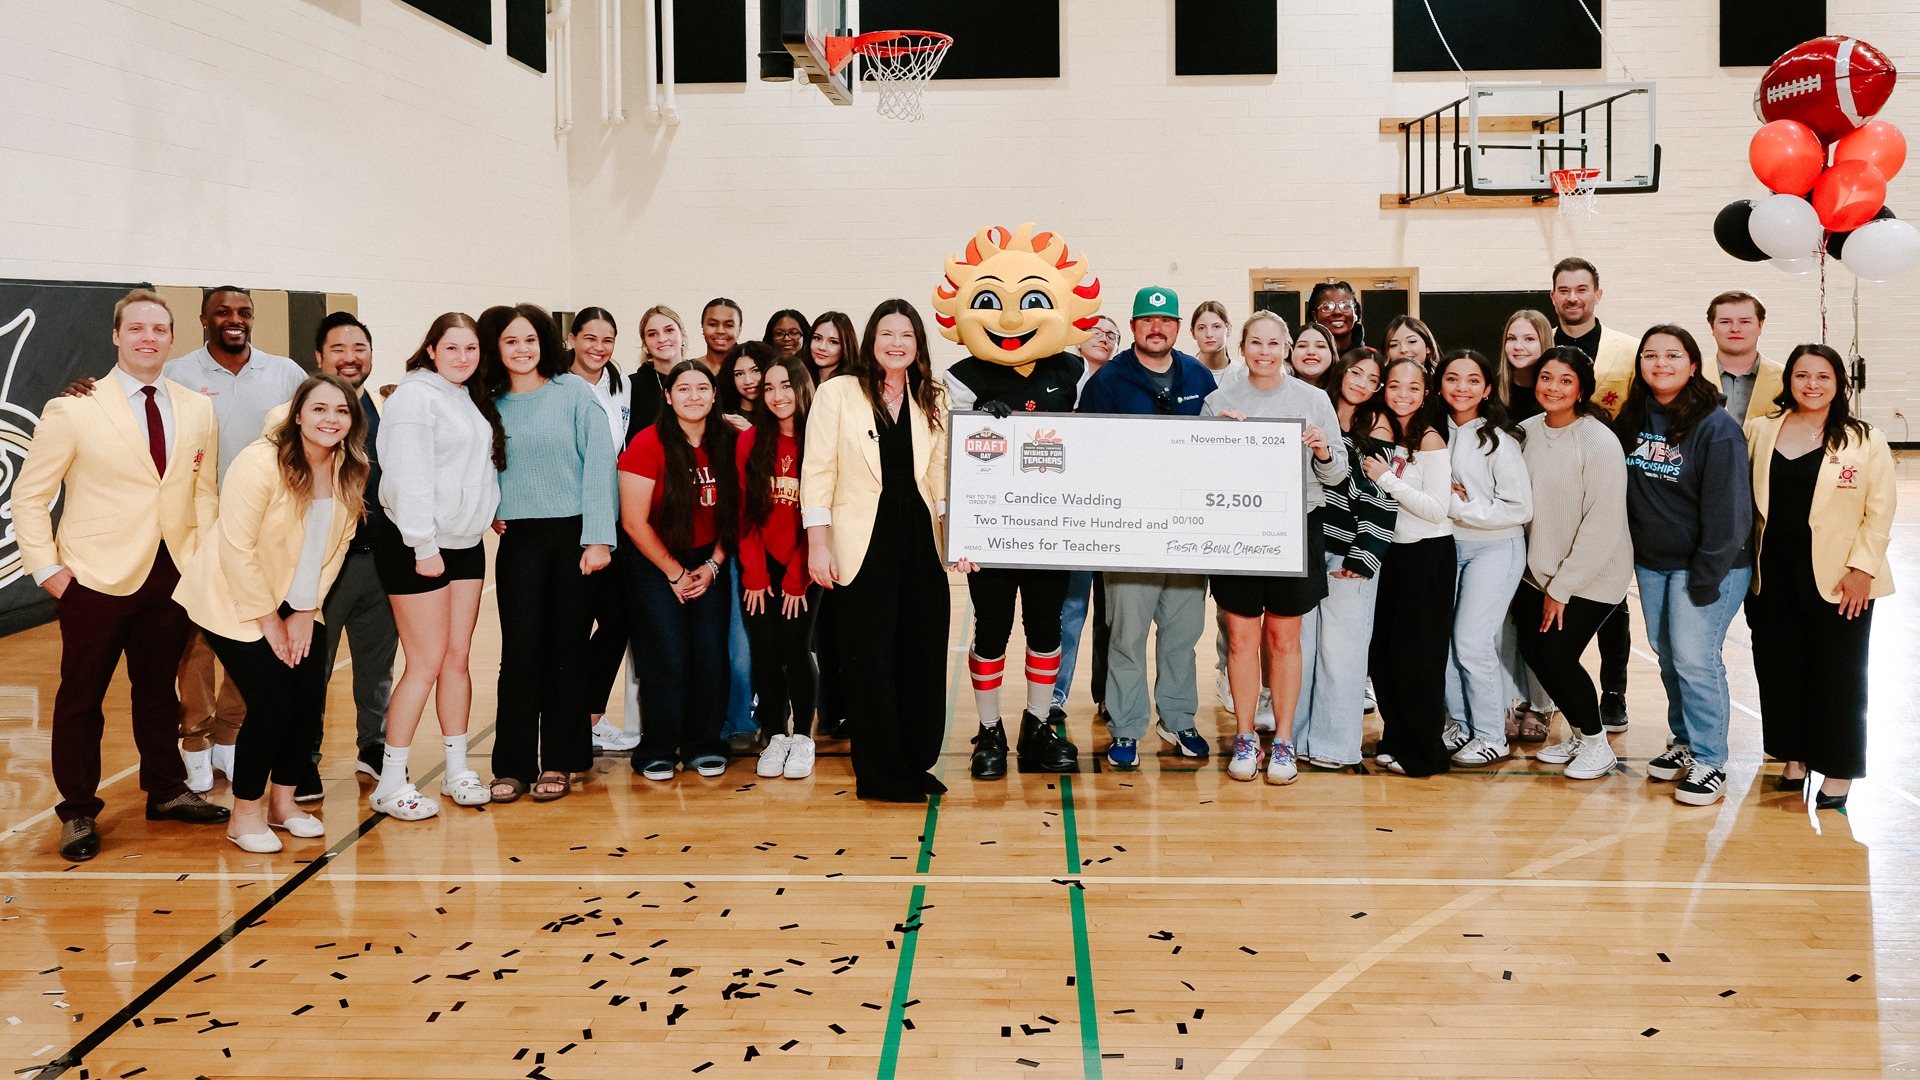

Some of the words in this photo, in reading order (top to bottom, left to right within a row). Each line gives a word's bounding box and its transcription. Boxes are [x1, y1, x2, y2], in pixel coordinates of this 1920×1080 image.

[967, 440, 1006, 452] DRAFT
[1190, 434, 1242, 444] November
[1245, 436, 1258, 446] 18,
[1261, 436, 1286, 445] 2024
[1023, 456, 1063, 466] TEACHERS
[1004, 491, 1058, 504] Candice
[1061, 493, 1122, 510] Wadding
[1205, 492, 1263, 509] $2,500
[973, 514, 998, 525] Two
[1001, 514, 1058, 527] Thousand
[1062, 516, 1087, 528] Five
[1090, 517, 1142, 529] Hundred
[1146, 519, 1169, 530] and
[1172, 515, 1205, 525] 00/100
[987, 537, 1034, 550] Wishes
[1038, 538, 1058, 551] for
[1062, 539, 1121, 553] Teachers
